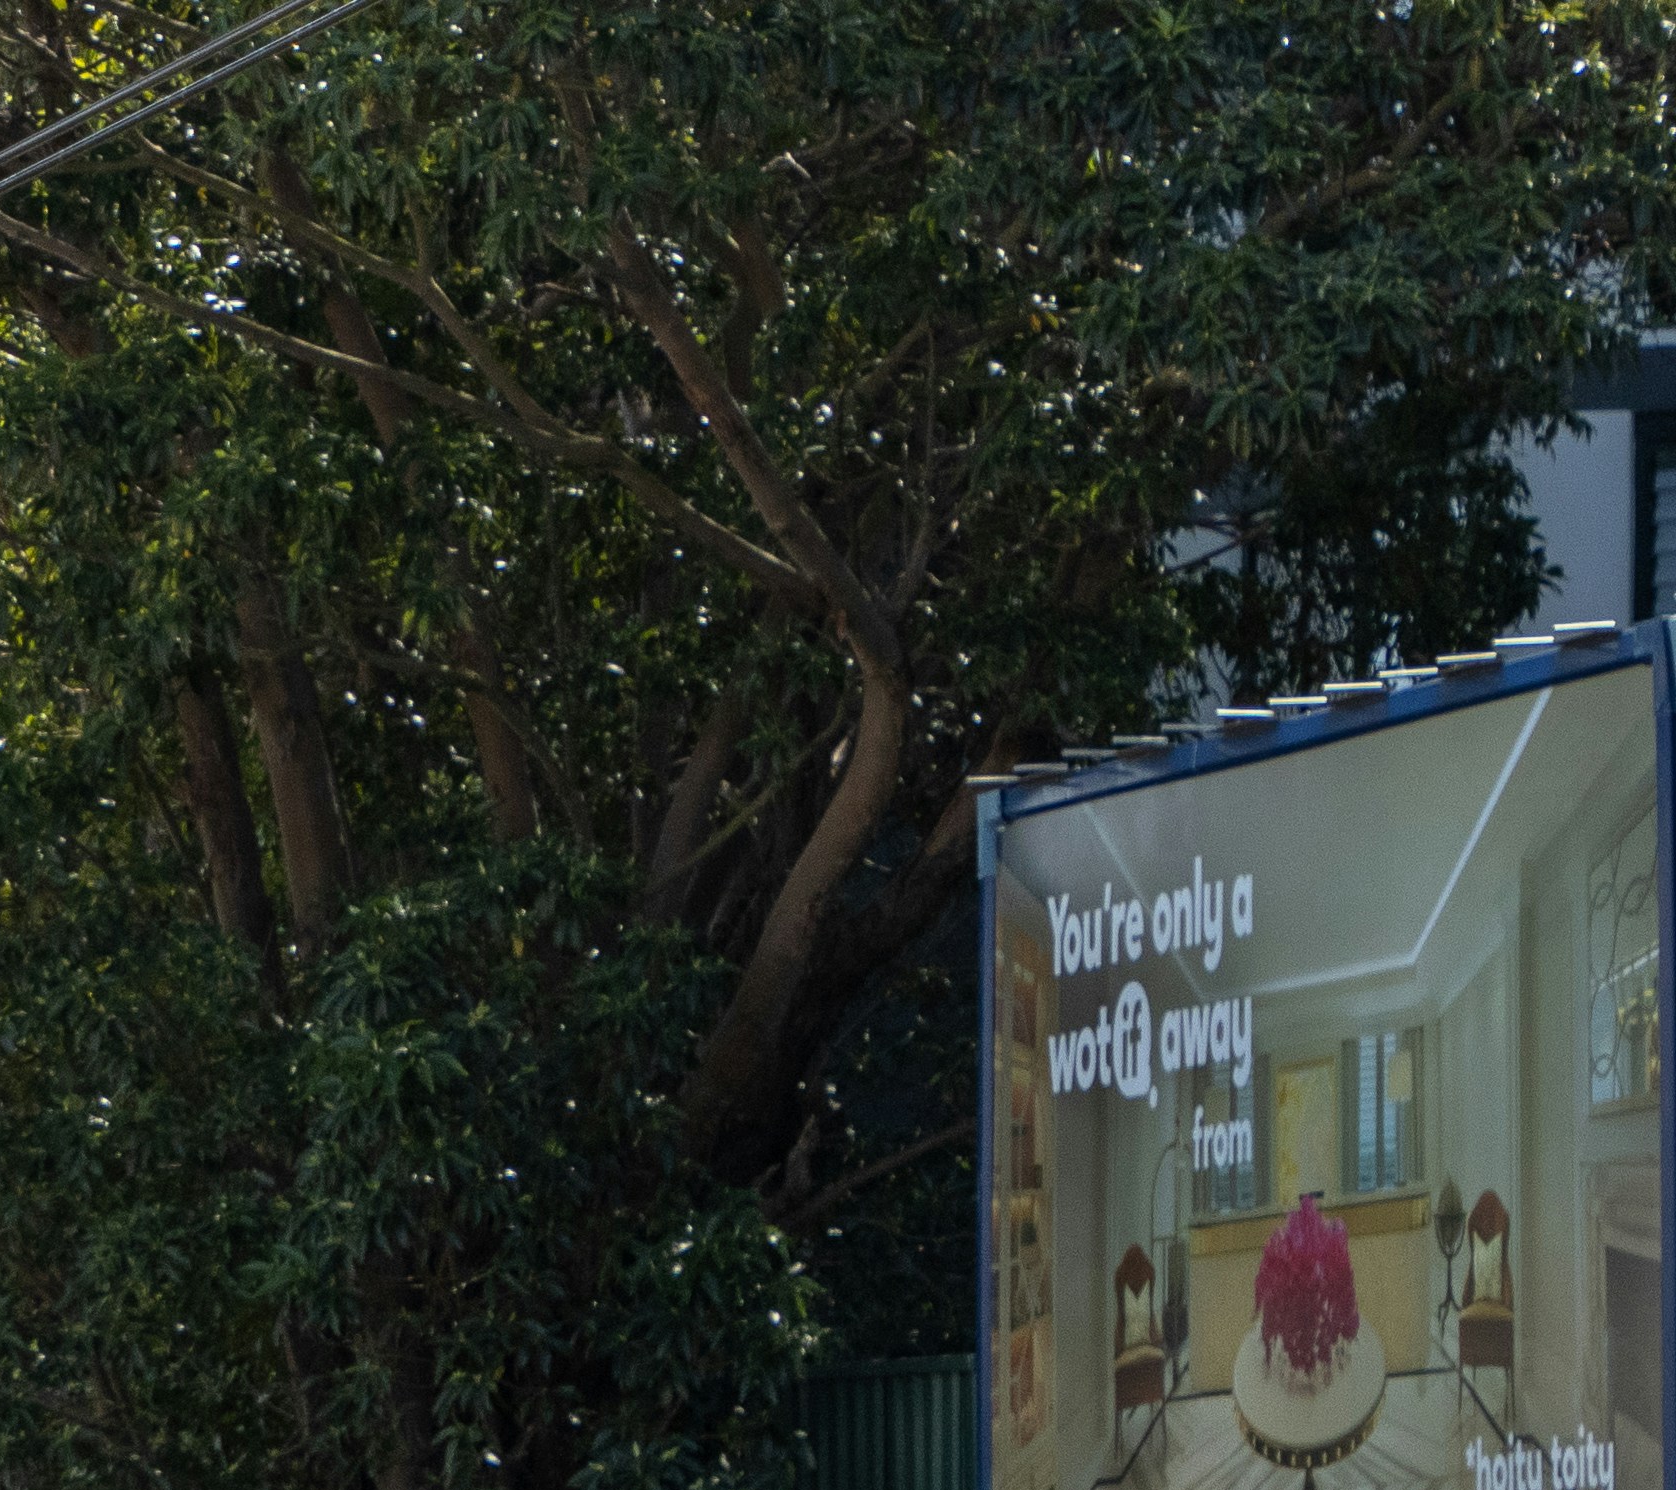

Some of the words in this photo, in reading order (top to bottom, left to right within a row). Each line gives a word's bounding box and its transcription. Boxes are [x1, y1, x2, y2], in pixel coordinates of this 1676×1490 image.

[1047, 881, 1144, 977] You're
[1152, 854, 1223, 972] only
[1231, 873, 1254, 938] a
[1160, 995, 1253, 1088] away
[1192, 1103, 1253, 1171] from
